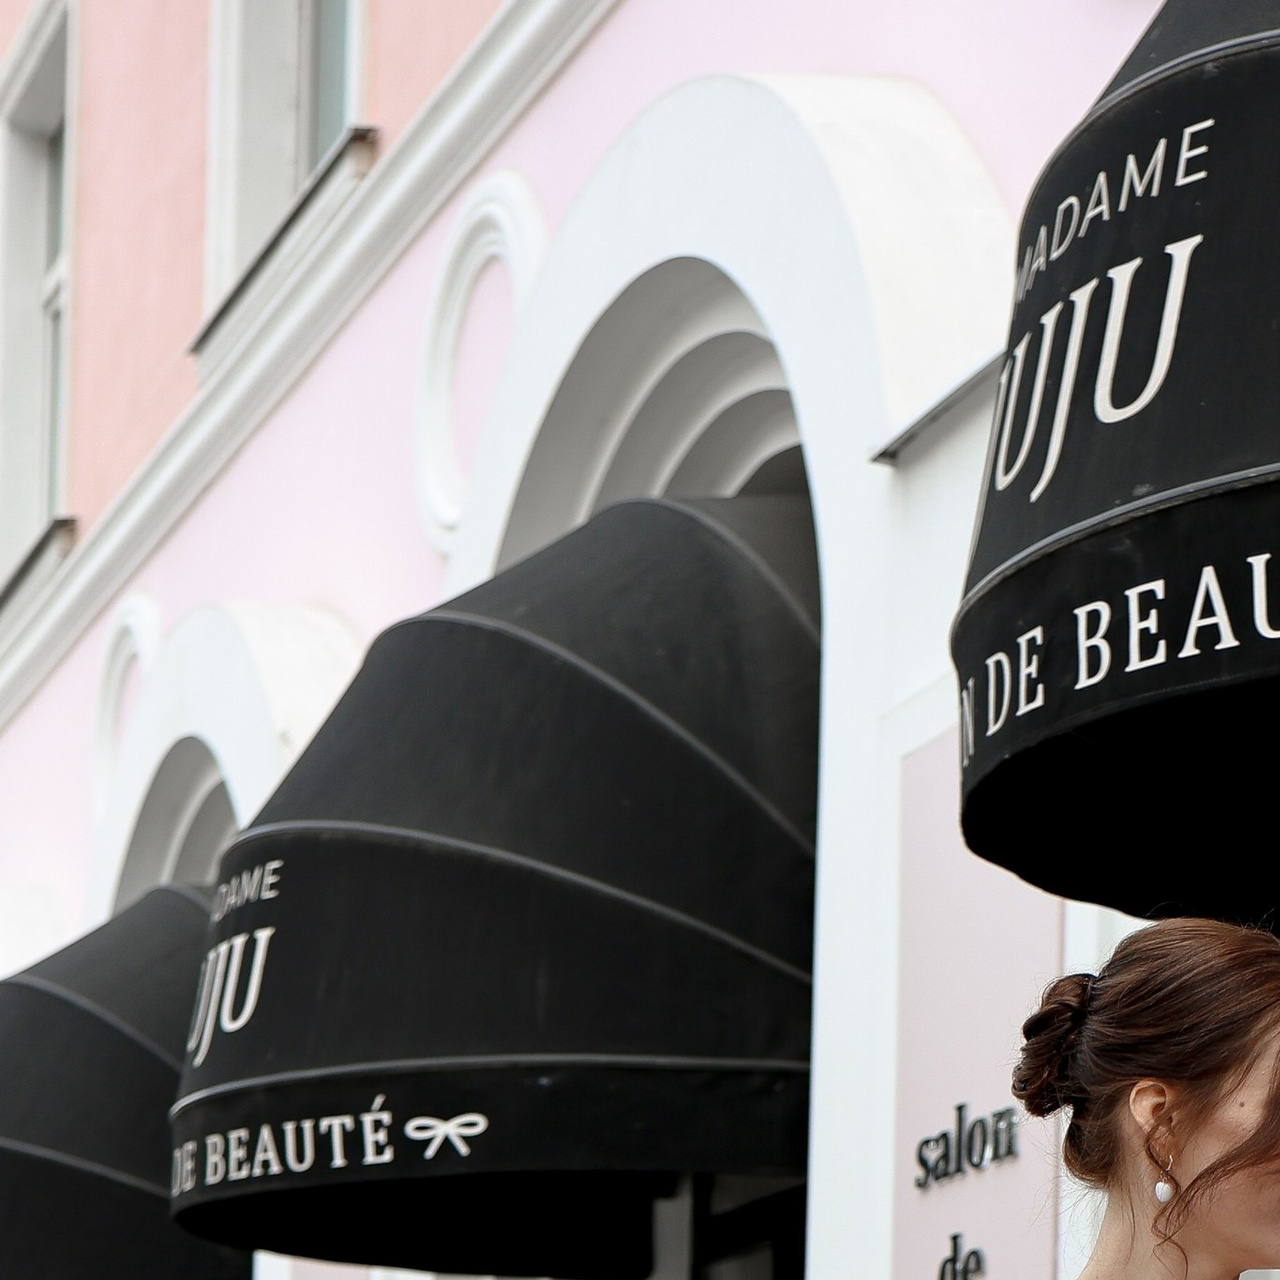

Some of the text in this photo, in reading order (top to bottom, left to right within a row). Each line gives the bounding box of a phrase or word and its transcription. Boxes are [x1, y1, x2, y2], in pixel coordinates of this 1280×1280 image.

[985, 625, 1045, 737] DE
[204, 1094, 395, 1186] BEAUTÉ
[914, 1102, 1019, 1189] salon
